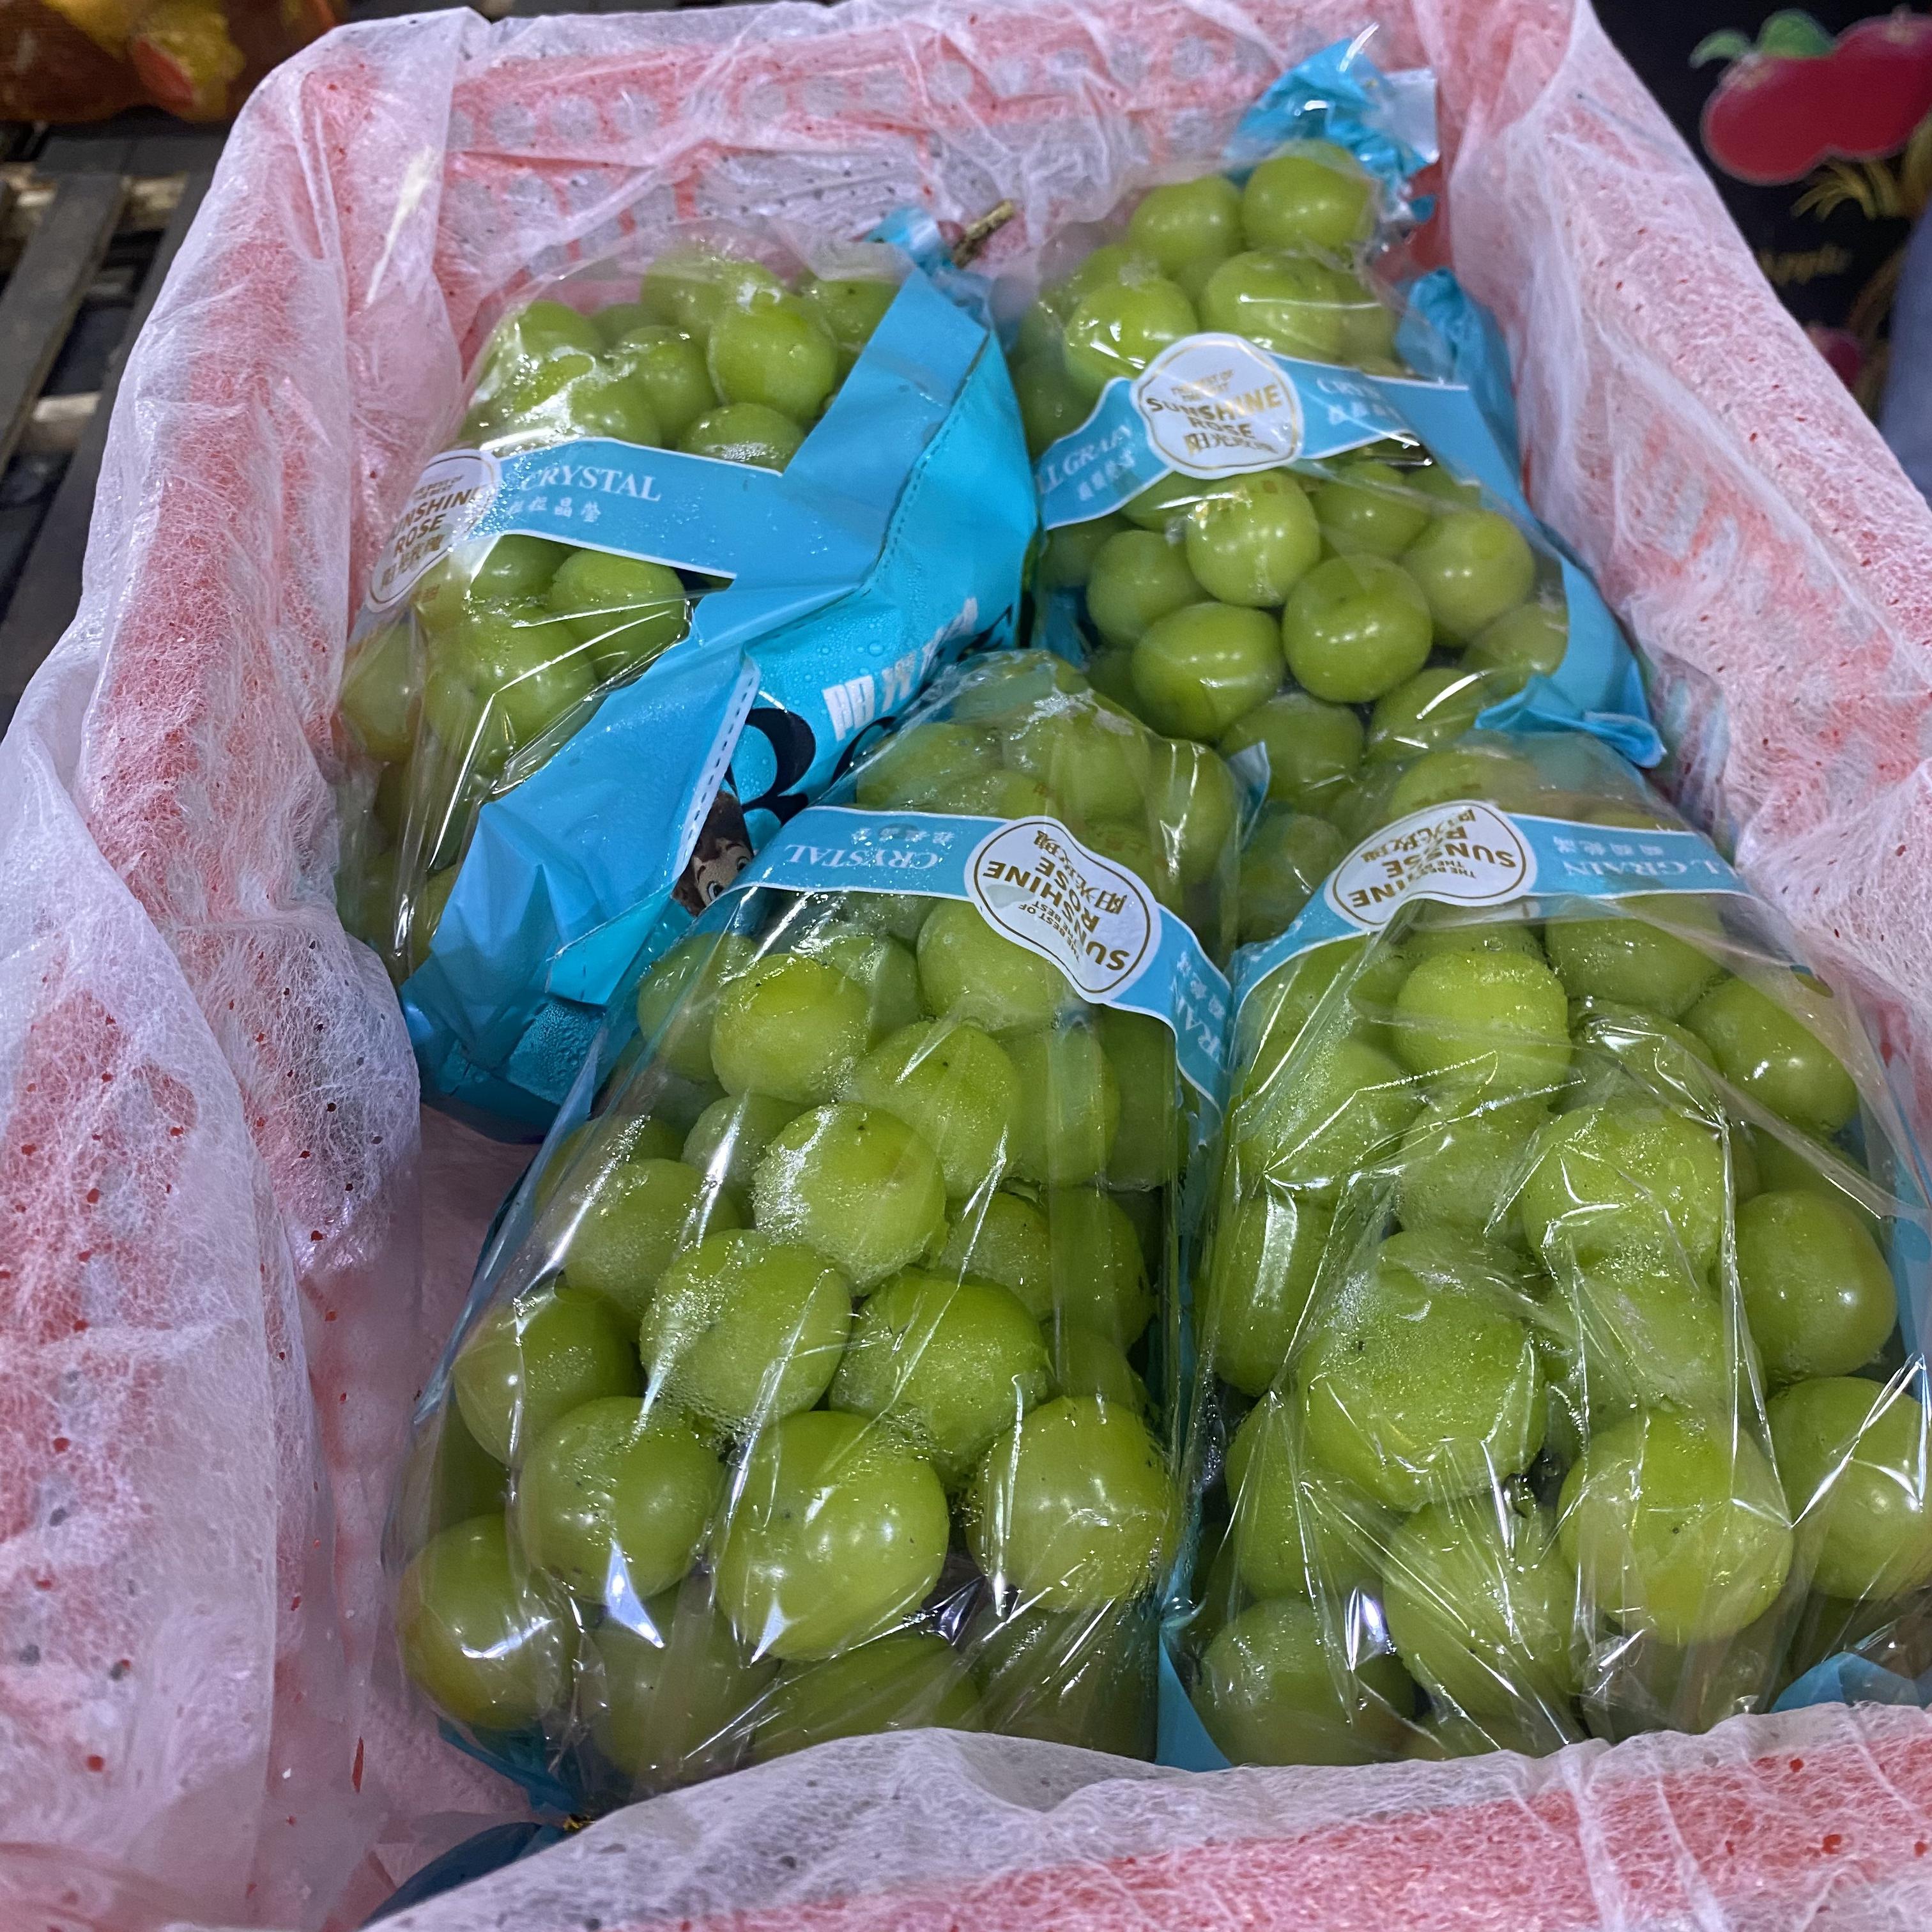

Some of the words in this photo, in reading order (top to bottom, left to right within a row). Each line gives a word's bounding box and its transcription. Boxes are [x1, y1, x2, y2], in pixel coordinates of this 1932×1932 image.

[1146, 384, 1283, 421] SUNSHINE
[520, 464, 661, 502] CRYSTAL
[393, 513, 447, 558] ROSE
[783, 843, 939, 870] CRYSTAL
[1563, 861, 1688, 876] GRAIN
[1018, 903, 1036, 915] OF
[1034, 856, 1100, 933] ROSE
[983, 861, 1130, 970] SUNSHINE
[1031, 900, 1061, 923] BEST
[1039, 913, 1066, 937] BEST
